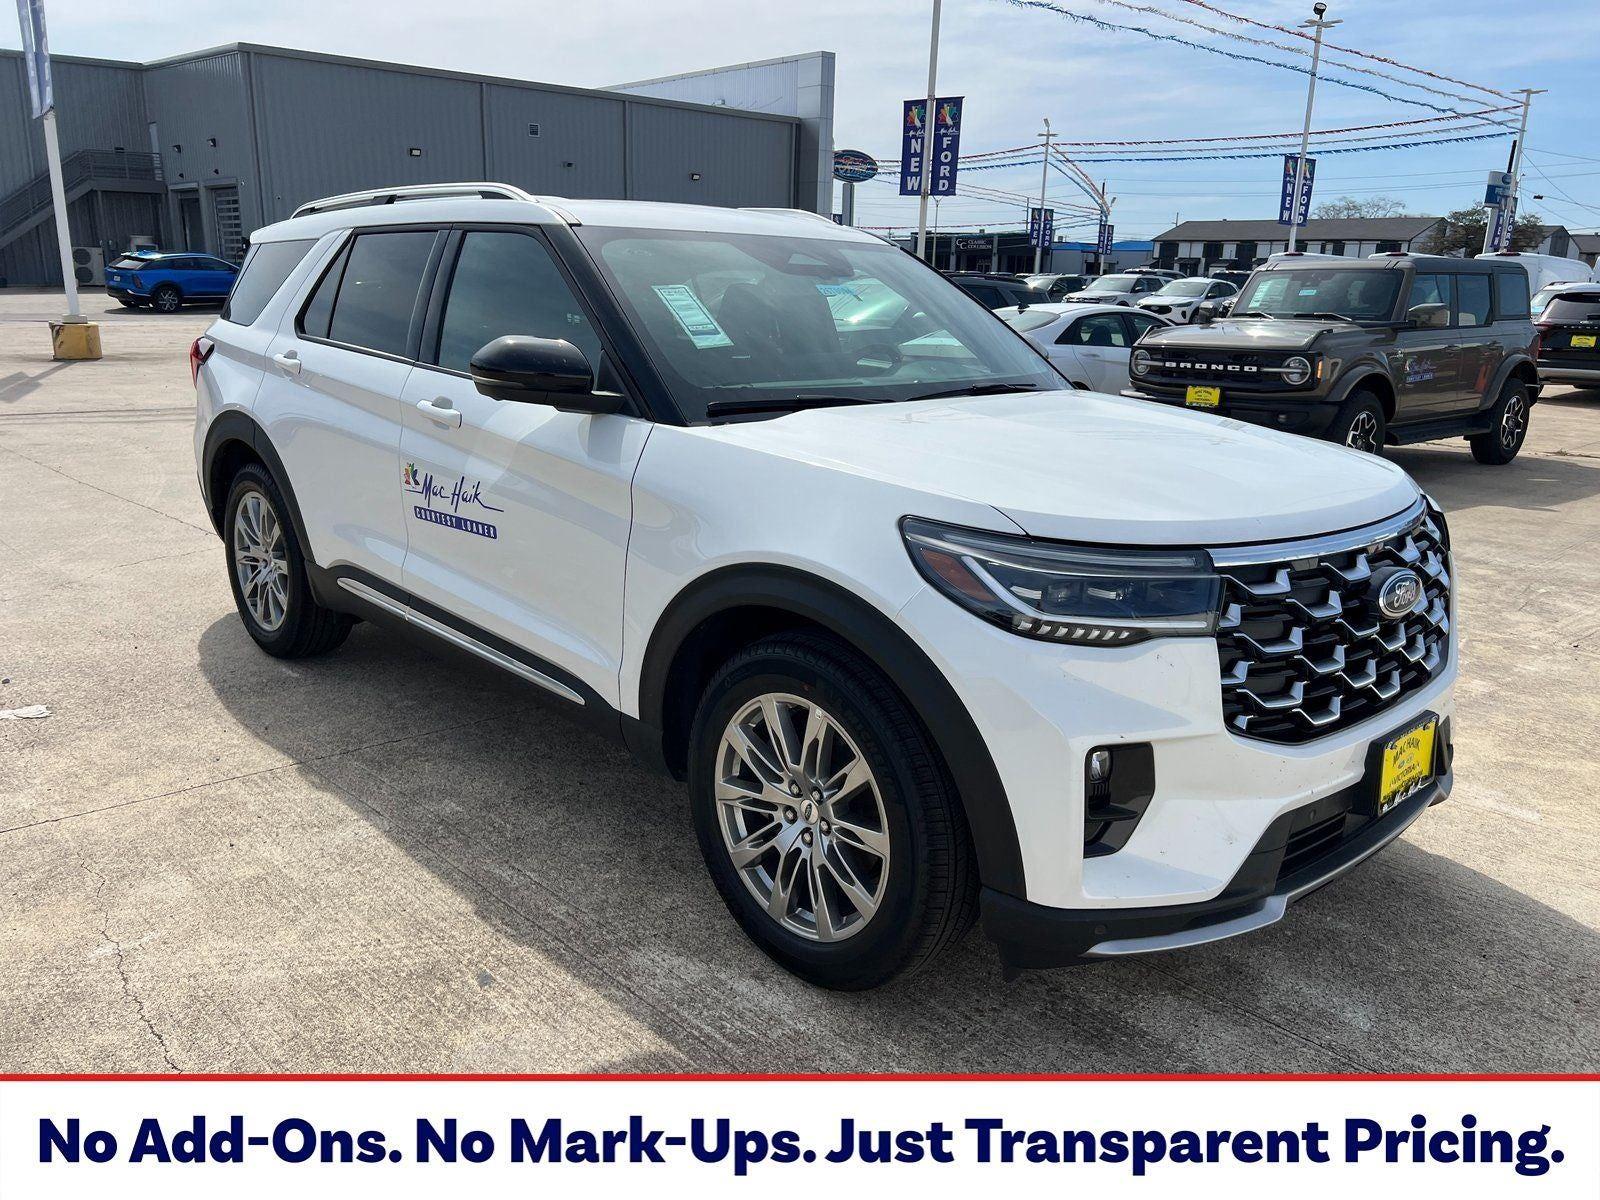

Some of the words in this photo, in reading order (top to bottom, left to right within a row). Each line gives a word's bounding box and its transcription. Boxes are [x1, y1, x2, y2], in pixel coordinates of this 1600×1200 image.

[906, 138, 921, 191] NEW
[938, 136, 952, 191] FORD
[1282, 183, 1293, 221] NEW
[1298, 185, 1309, 224] FORD
[1165, 361, 1258, 372] BRONCO
[410, 473, 450, 508] Mac
[450, 476, 499, 513] Haik
[415, 507, 456, 528] COURTESY
[461, 517, 495, 538] LOANER
